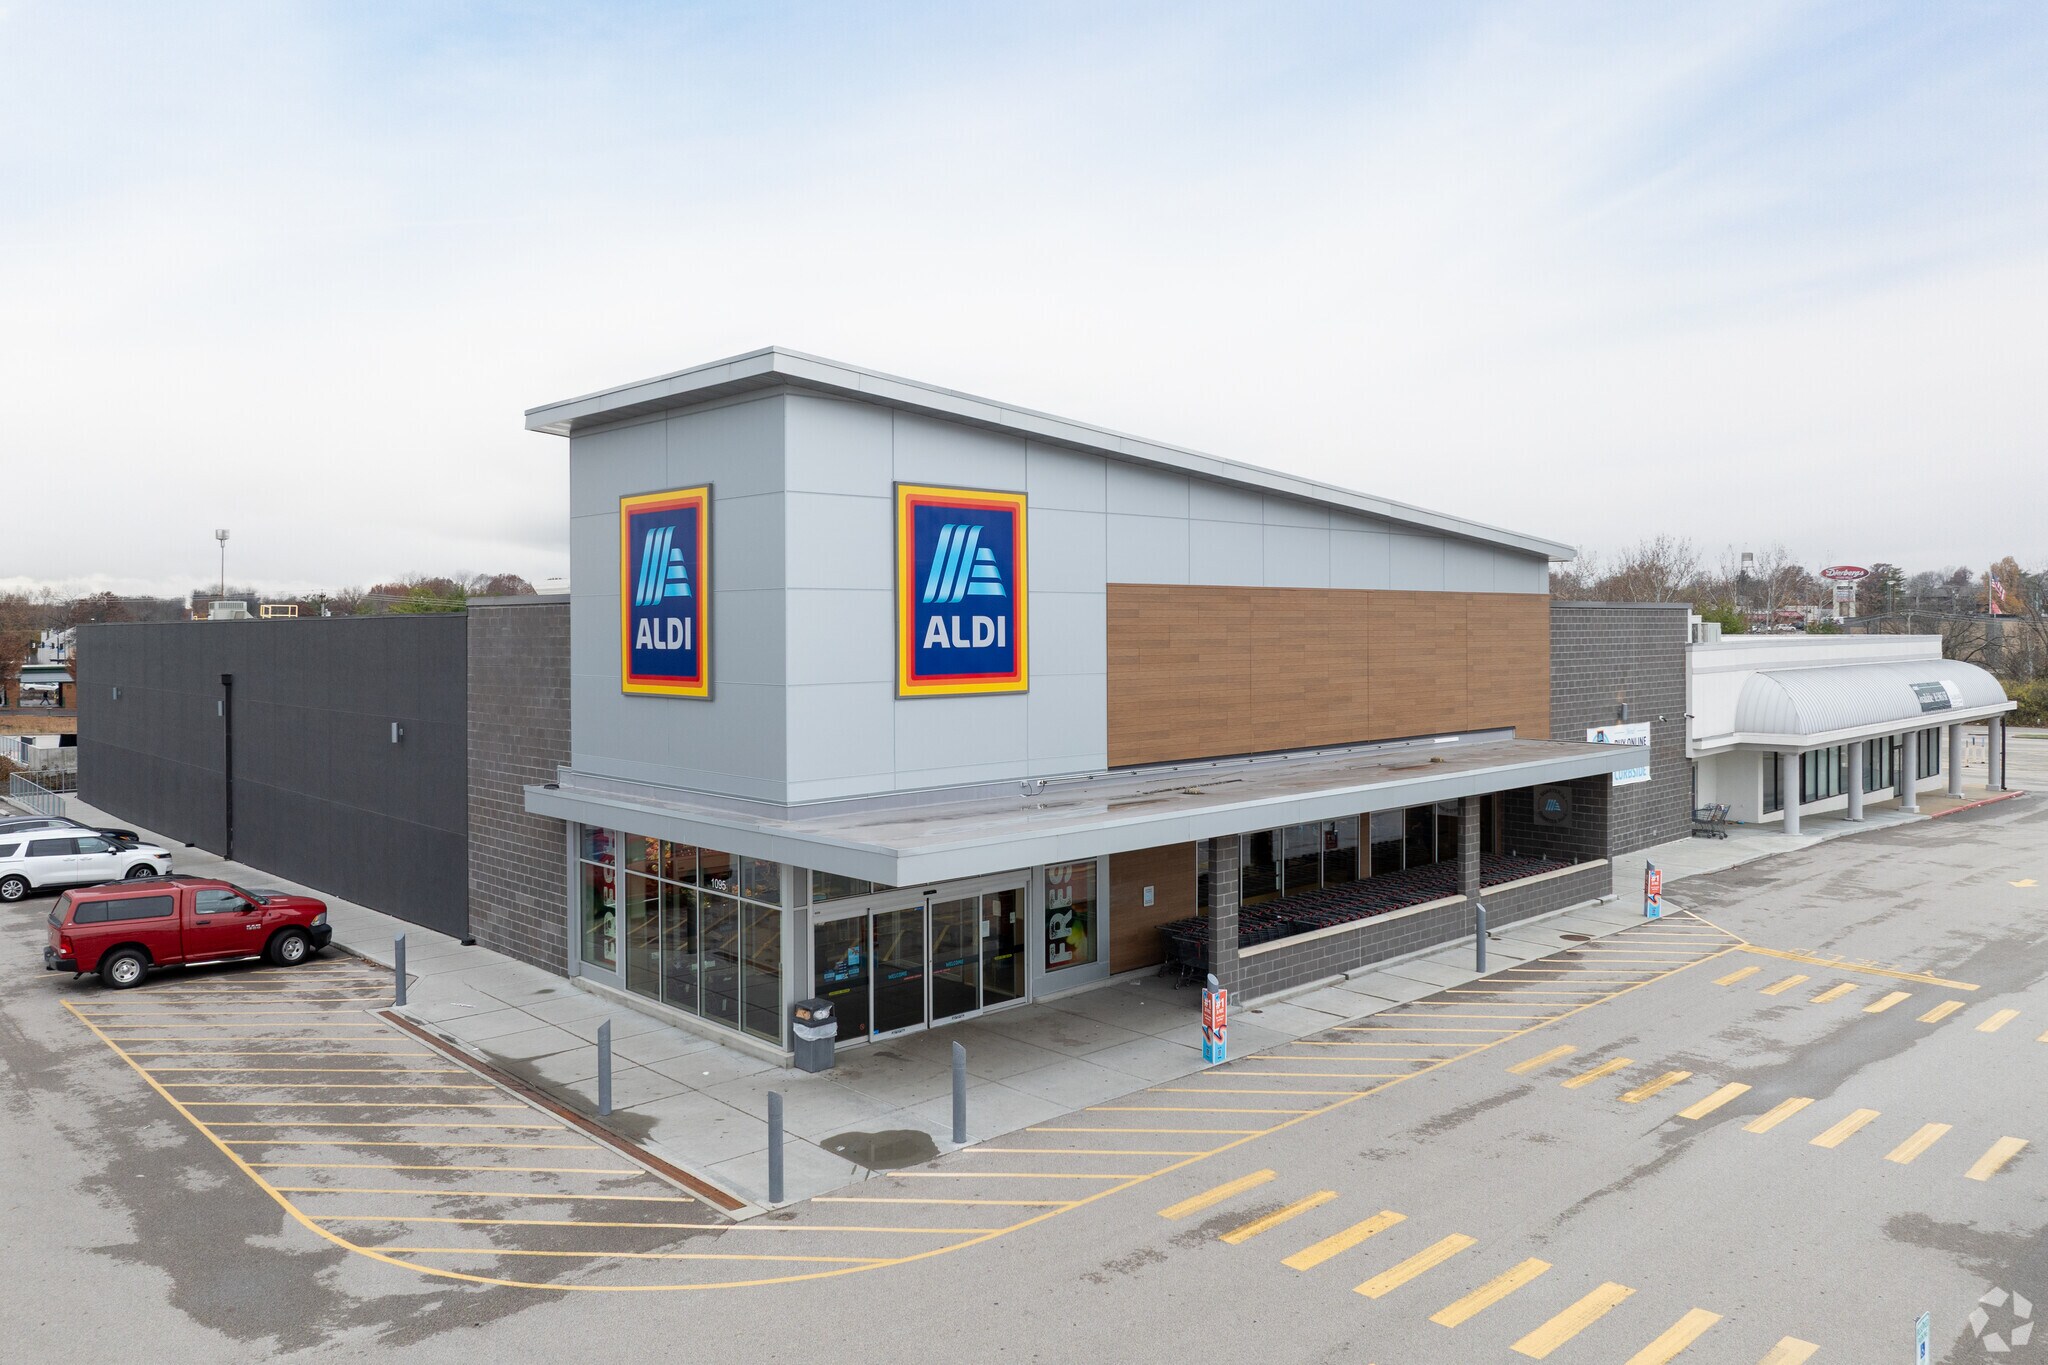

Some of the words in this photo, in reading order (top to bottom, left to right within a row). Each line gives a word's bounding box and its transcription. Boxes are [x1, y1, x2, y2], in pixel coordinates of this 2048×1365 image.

[1826, 567, 1864, 577] Dierbergs
[636, 617, 691, 650] ALDI
[923, 615, 1006, 649] ALDI
[1215, 998, 1225, 1009] #1
